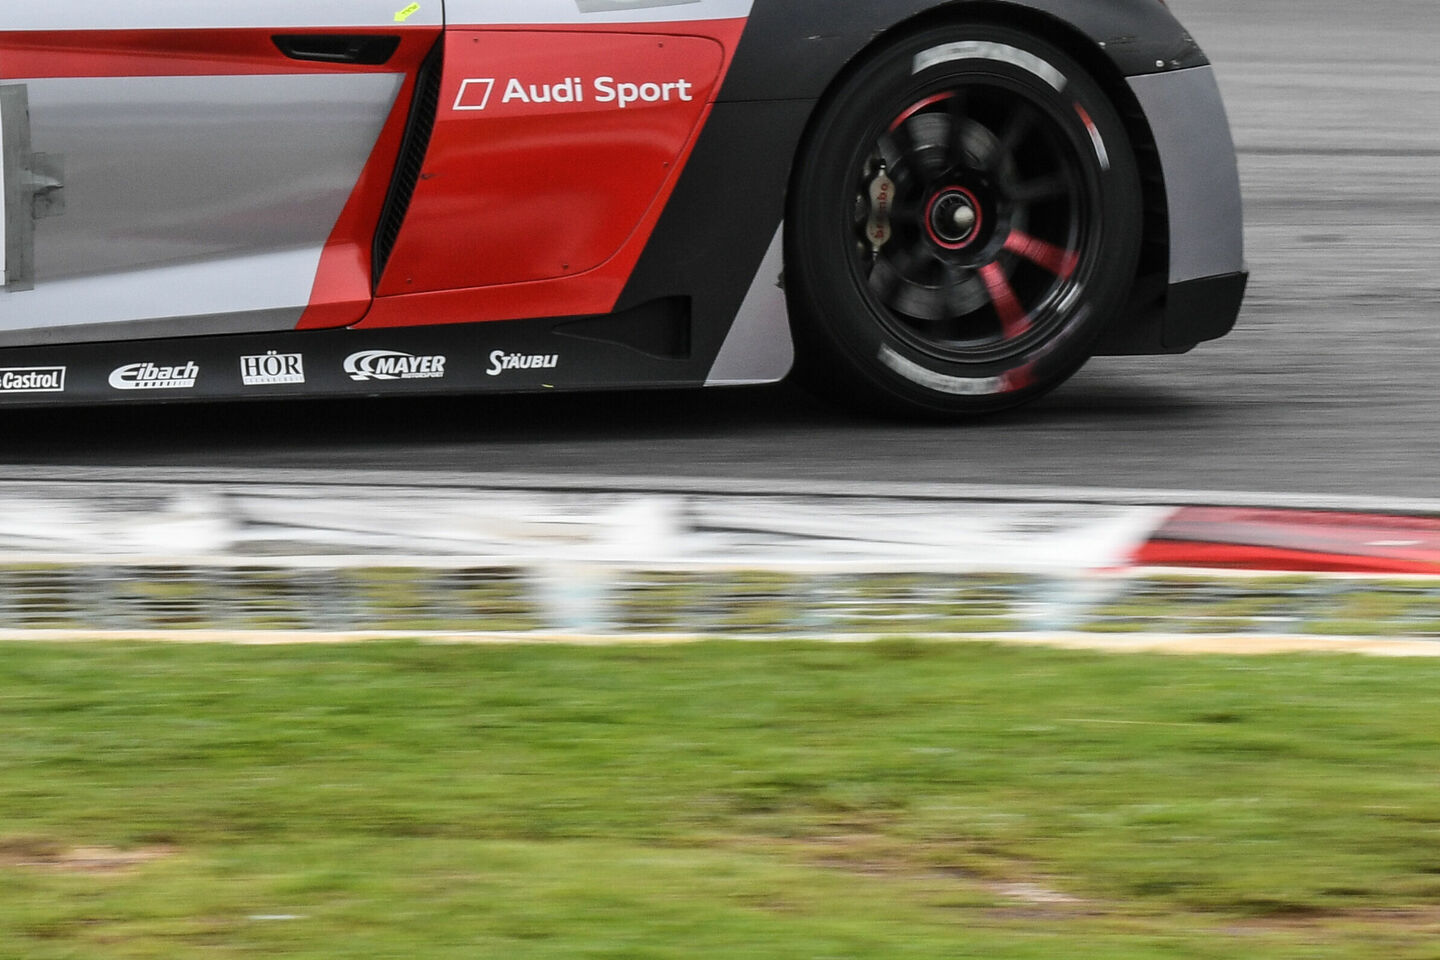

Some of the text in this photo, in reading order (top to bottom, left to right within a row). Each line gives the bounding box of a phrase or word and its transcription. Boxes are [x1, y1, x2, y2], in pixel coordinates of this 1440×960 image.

[502, 77, 692, 108] Audi Sport
[108, 361, 199, 390] Eibach
[243, 350, 301, 376] HÖR
[375, 355, 446, 374] MAYER
[486, 351, 558, 376] STÄUBLI
[3, 372, 58, 389] Castrol
